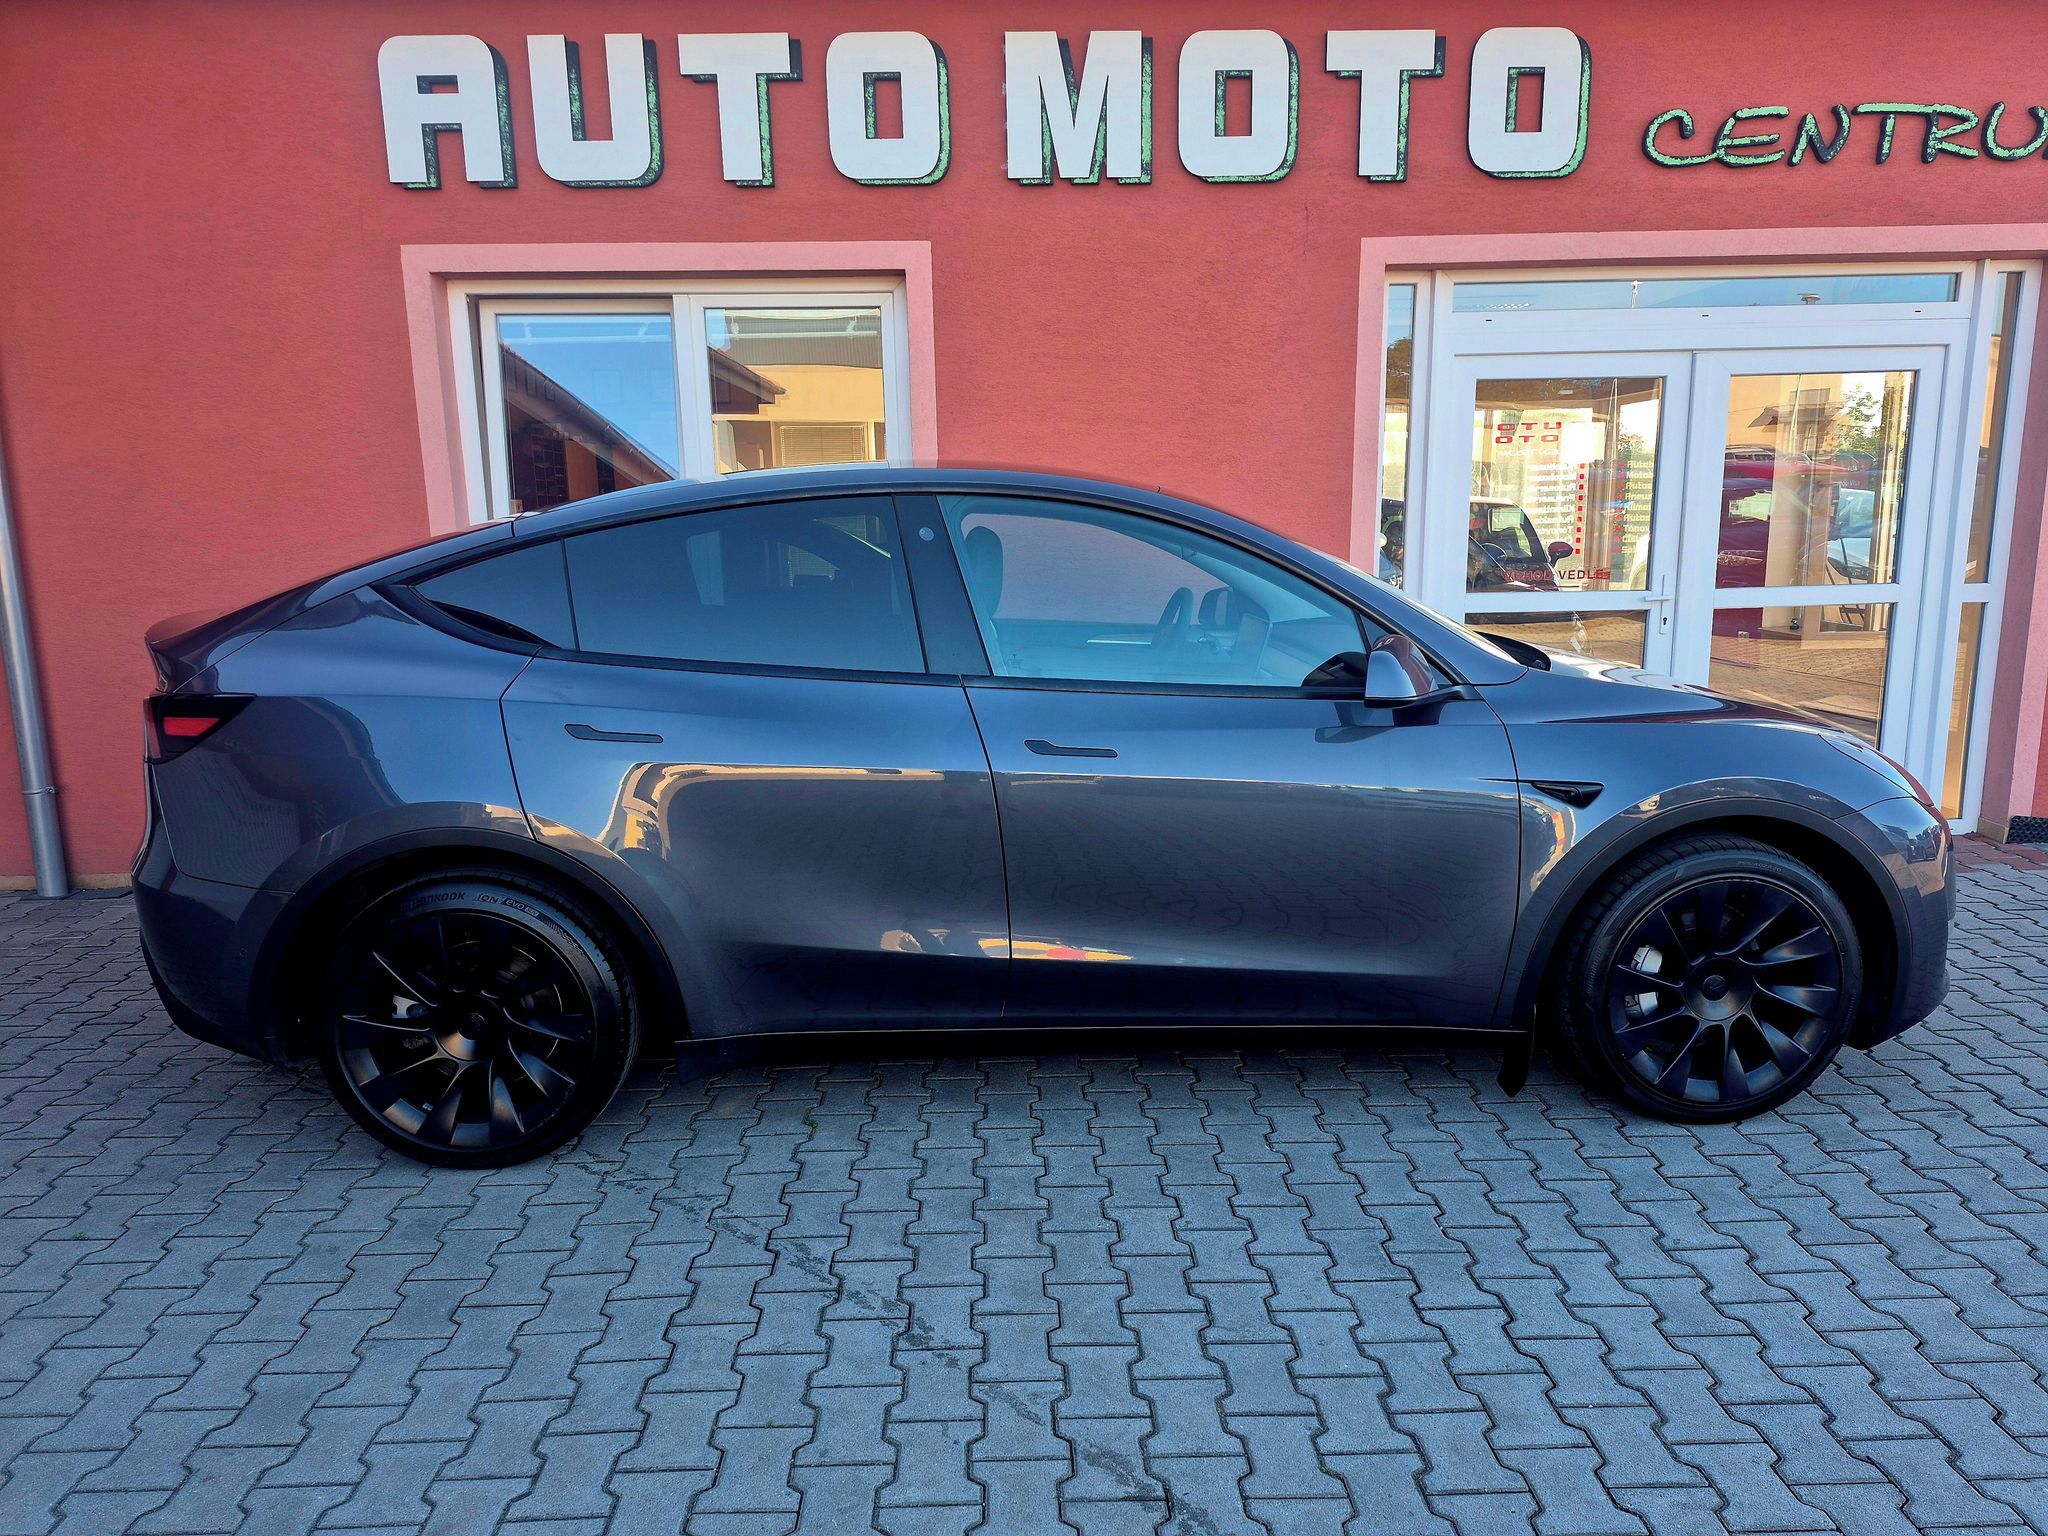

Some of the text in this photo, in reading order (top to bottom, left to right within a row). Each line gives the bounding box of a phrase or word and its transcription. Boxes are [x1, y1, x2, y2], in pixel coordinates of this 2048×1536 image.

[377, 27, 1592, 189] AUTO MOTO
[1641, 101, 2048, 168] CENTRU
